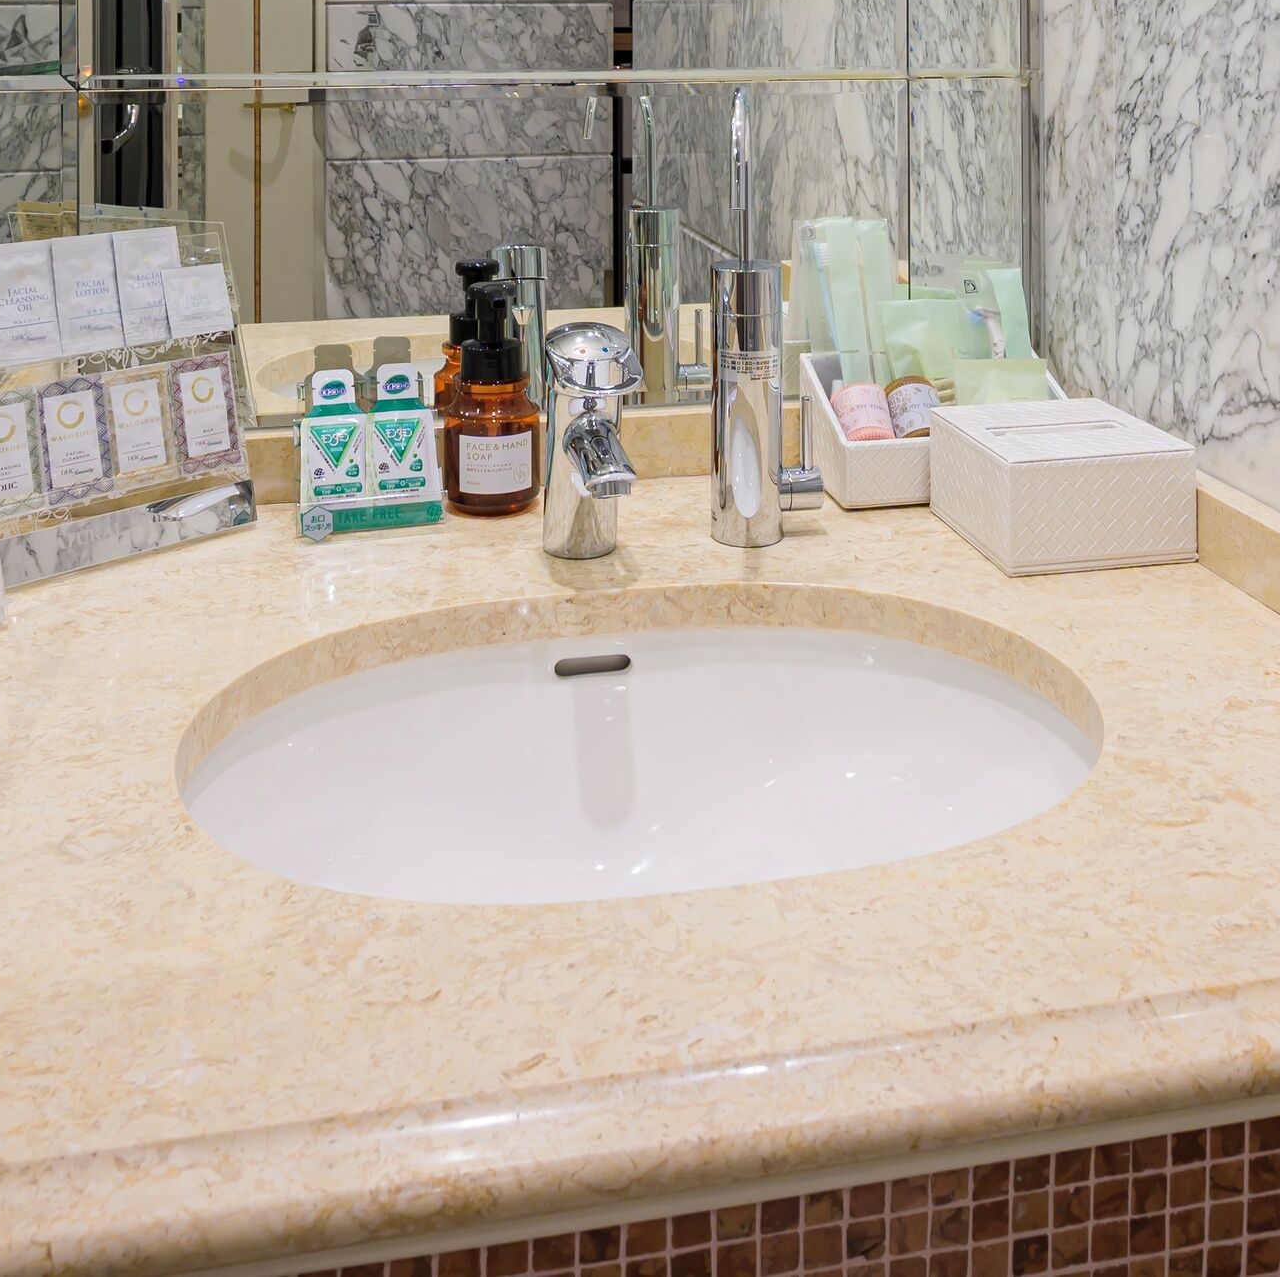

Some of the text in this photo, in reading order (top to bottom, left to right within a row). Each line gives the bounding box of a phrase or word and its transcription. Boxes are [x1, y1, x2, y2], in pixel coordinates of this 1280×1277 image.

[136, 272, 161, 282] FACIA
[76, 278, 106, 289] FACIAL
[7, 286, 38, 297] FACIAL
[75, 286, 110, 298] LOTION
[17, 304, 33, 312] OIL
[466, 439, 528, 451] FACE & HAND
[466, 452, 493, 461] SOAP
[310, 514, 326, 523] お口
[338, 507, 401, 524] TAKE FREE
